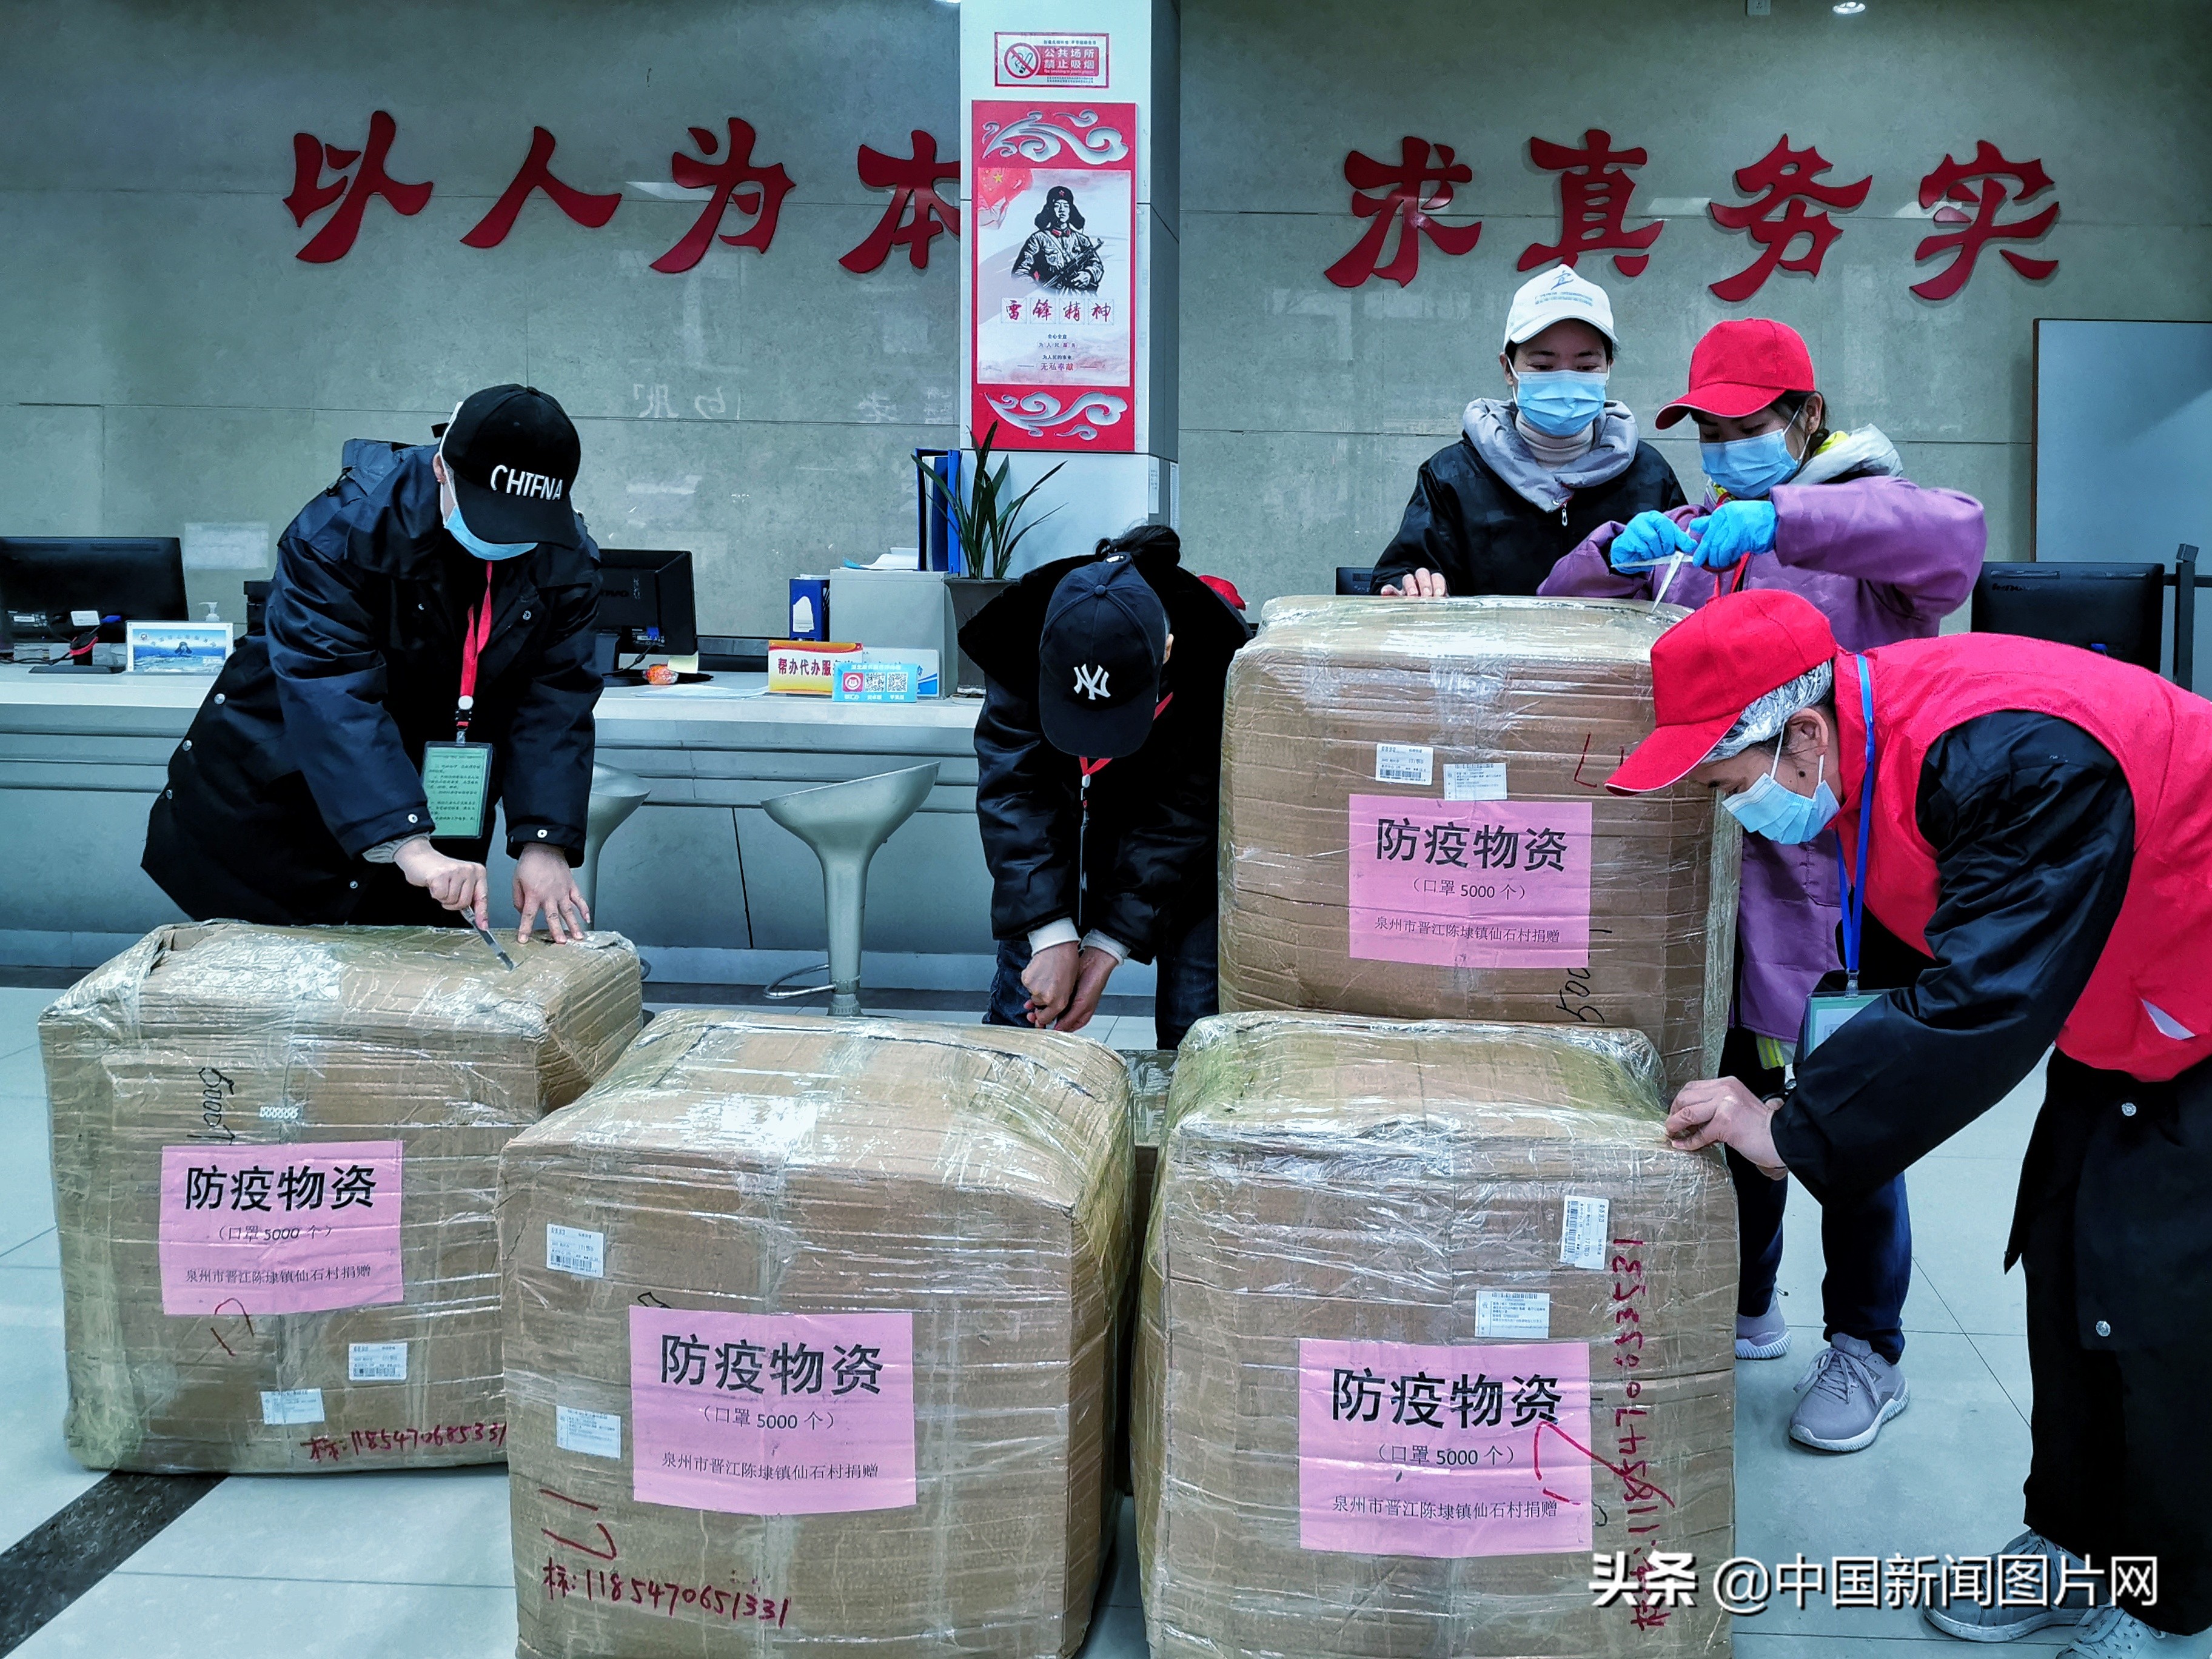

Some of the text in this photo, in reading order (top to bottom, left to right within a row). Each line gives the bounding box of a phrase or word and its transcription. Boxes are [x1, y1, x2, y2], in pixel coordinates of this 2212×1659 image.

[1044, 48, 1094, 58] 公共场所
[1044, 59, 1094, 69] 禁止吸烟
[283, 110, 962, 273] 以人为本
[1324, 129, 2059, 301] 求真务实
[1006, 298, 1111, 322] 雷锋精神
[1041, 362, 1074, 371] 无私奉献
[777, 657, 842, 677] 帮办代办服
[1073, 663, 1111, 700] NY
[1376, 818, 1568, 871] 防疫物资
[1375, 916, 1560, 943] 泉州市晋江陈埭镇仙石村捐赠
[185, 1165, 377, 1212] 防疫物资
[186, 1264, 371, 1284] 泉州市晋江陈埭镇仙石村捐赠
[660, 1333, 883, 1395] 防疫物资
[1332, 1367, 1562, 1429] 防疫物资
[662, 1450, 879, 1480] 泉州市晋江陈埭镇仙石村捐赠
[1332, 1494, 1558, 1521] 泉州市晋江陈埭镇仙石村捐赠
